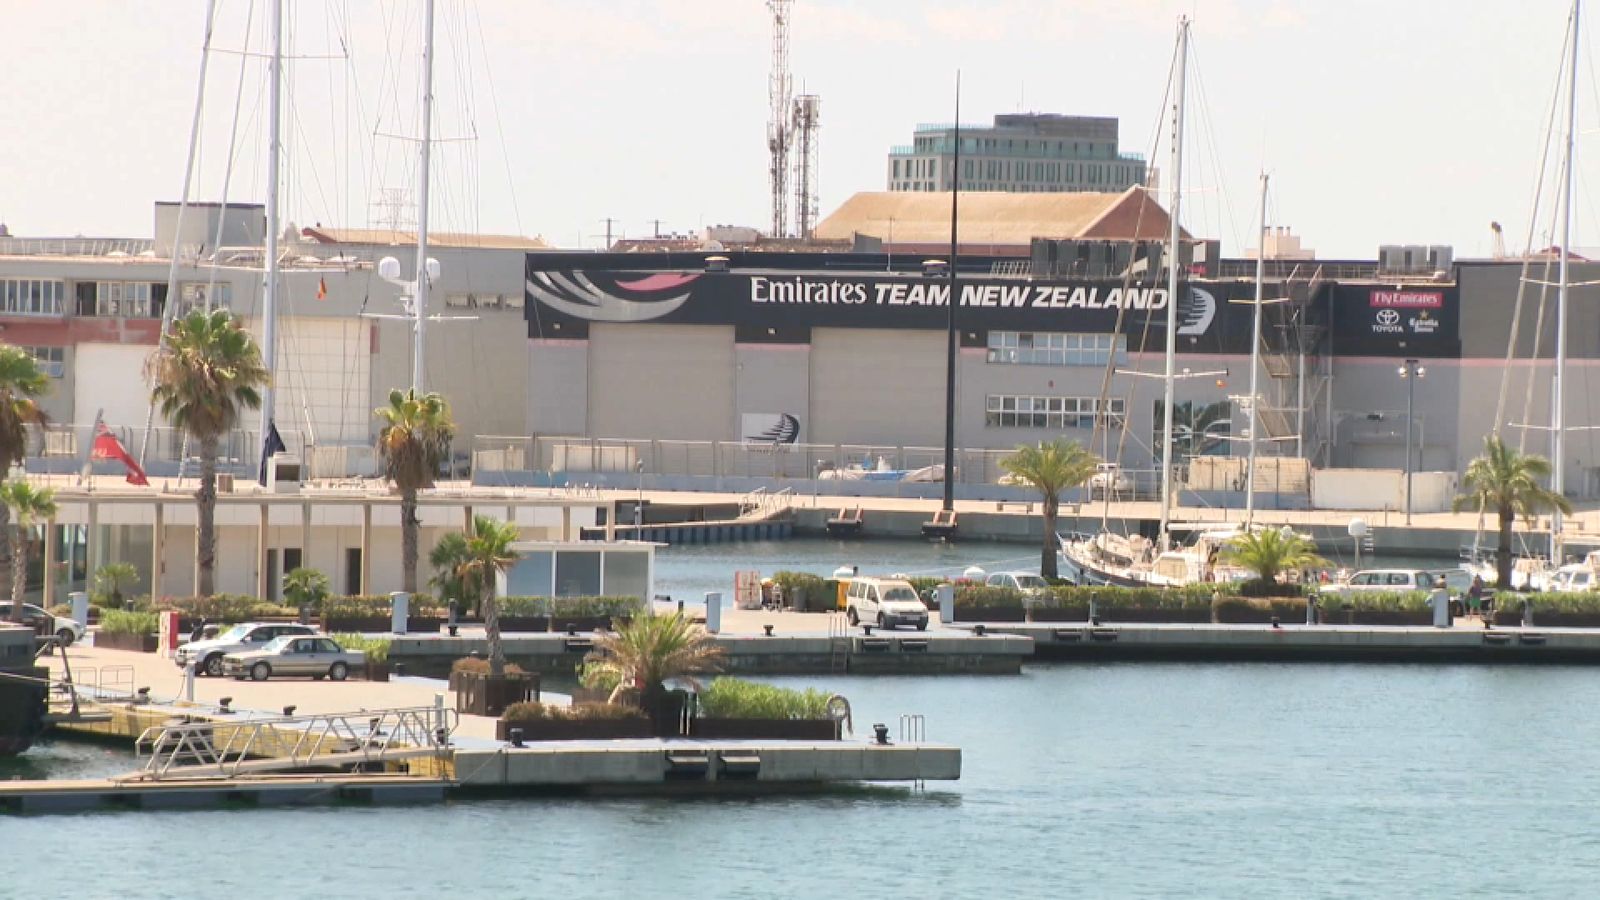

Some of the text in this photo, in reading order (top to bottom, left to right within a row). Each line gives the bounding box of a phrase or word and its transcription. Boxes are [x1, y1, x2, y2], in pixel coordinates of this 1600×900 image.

[750, 276, 1168, 309] Emirates TEAM NEW ZEALAND
[1375, 291, 1438, 304] Fly Emirates
[1372, 325, 1403, 333] TOYOTA
